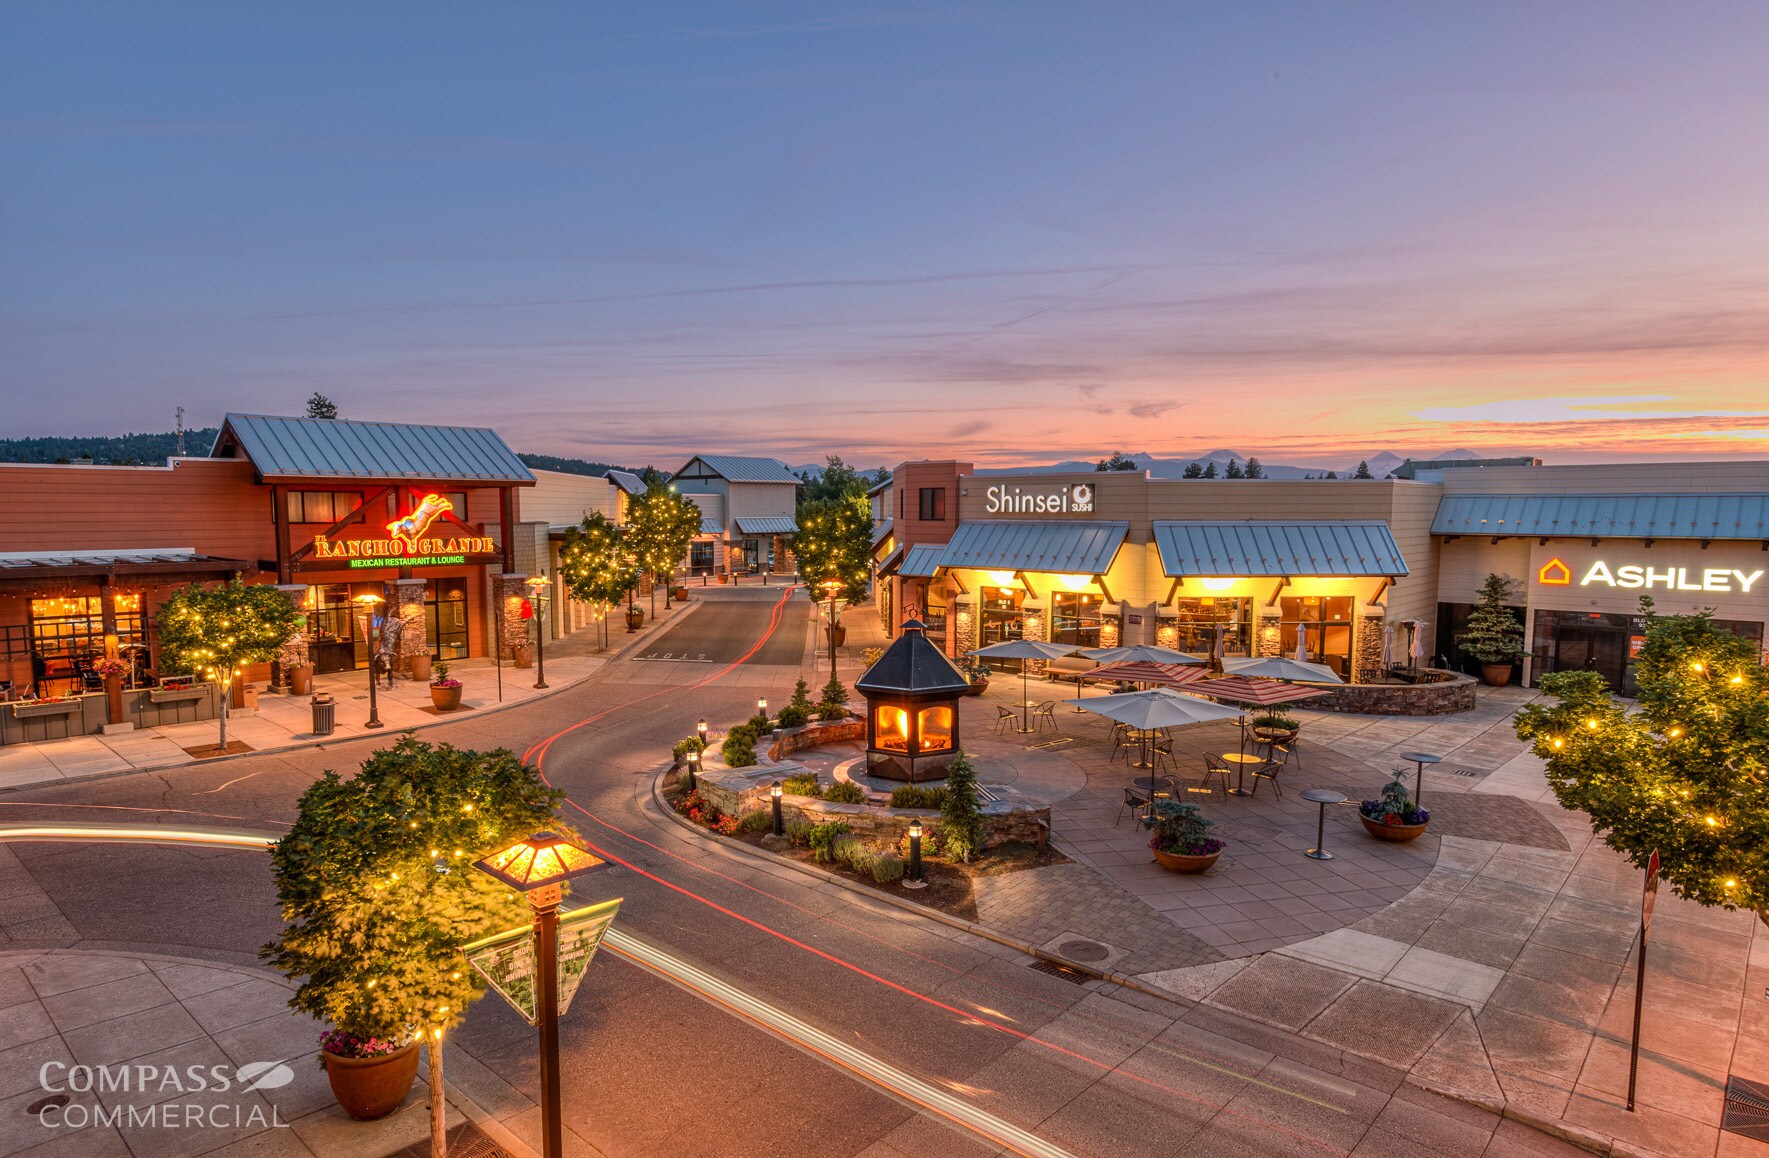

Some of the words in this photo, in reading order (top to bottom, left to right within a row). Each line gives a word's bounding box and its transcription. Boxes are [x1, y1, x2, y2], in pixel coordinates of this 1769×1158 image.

[986, 484, 1068, 513] Shinsei
[1071, 503, 1093, 512] SUSHI
[315, 540, 403, 557] RANCHO
[418, 537, 494, 555] GRANDE
[351, 558, 384, 568] MEXICAN
[385, 557, 430, 567] RESTAURANT
[431, 557, 437, 565] &
[437, 555, 465, 565] LOUNGE
[1580, 560, 1765, 593] ASHLEY
